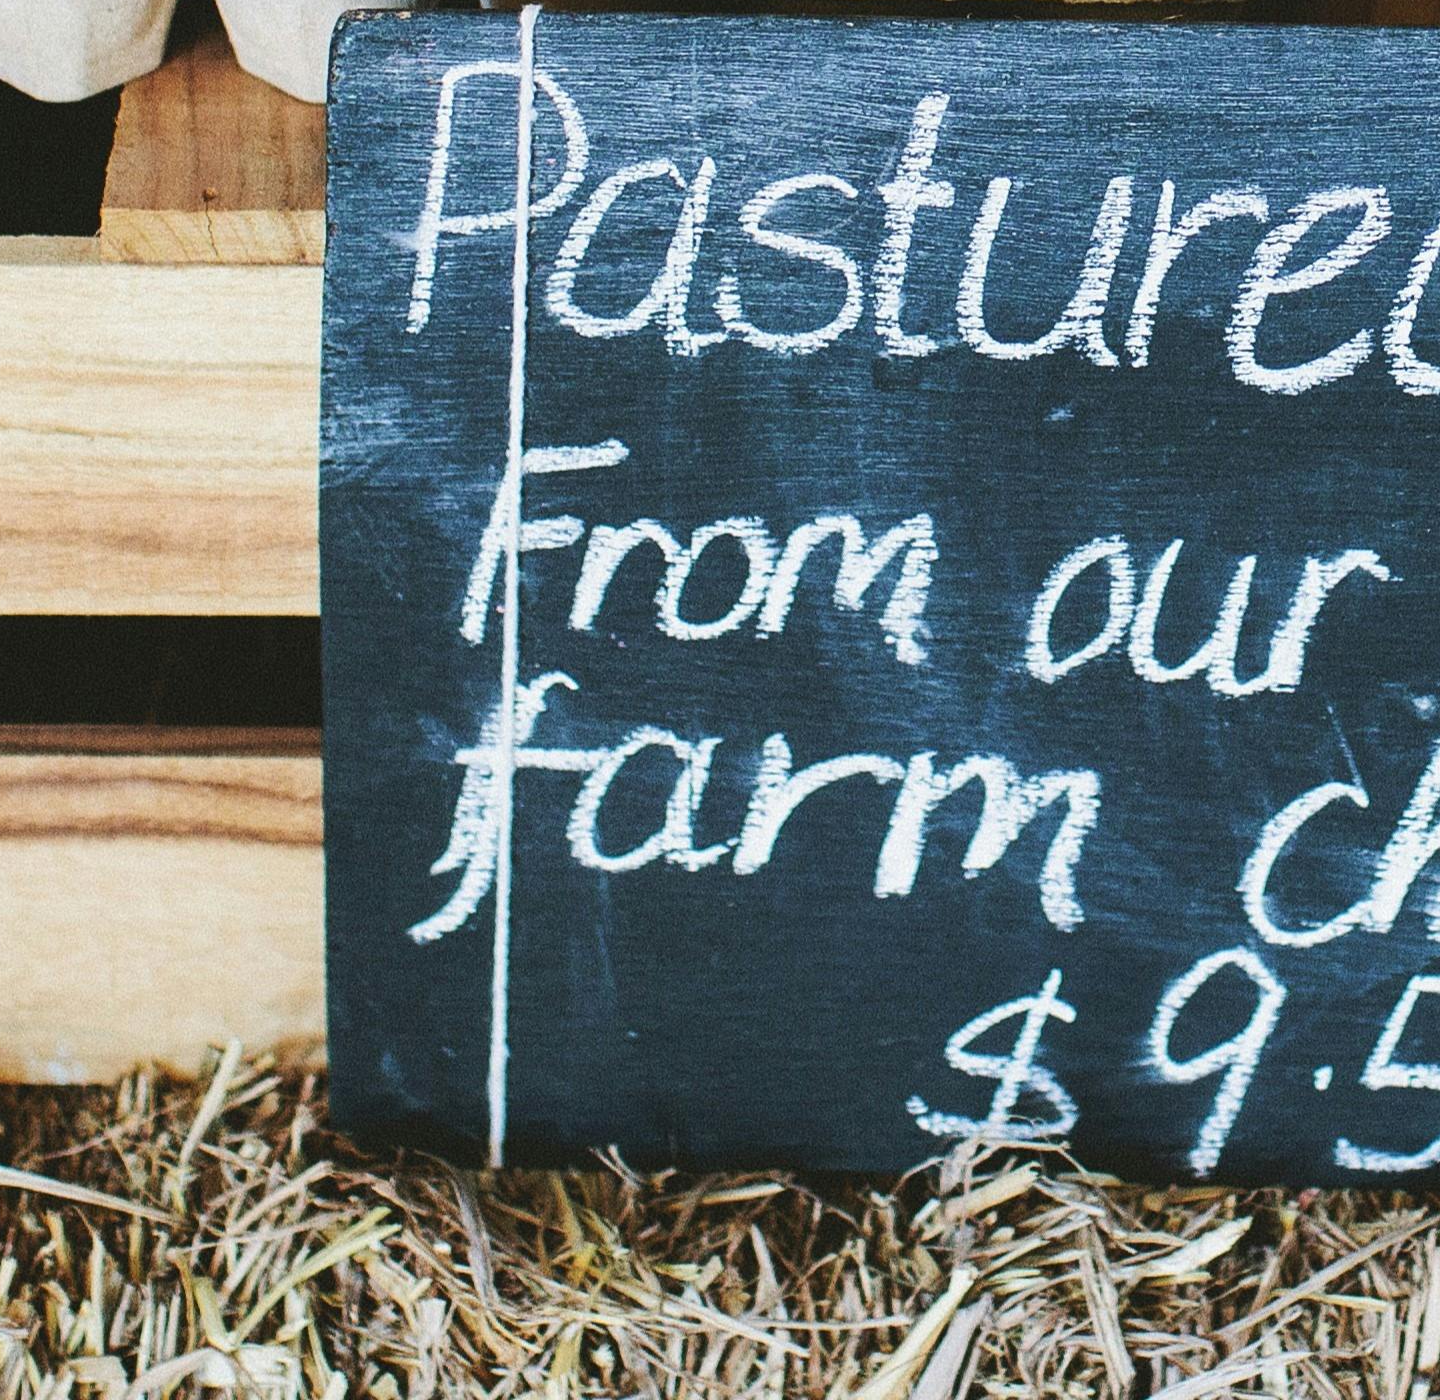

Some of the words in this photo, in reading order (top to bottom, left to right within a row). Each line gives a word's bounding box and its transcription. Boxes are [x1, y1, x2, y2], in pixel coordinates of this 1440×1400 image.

[461, 438, 938, 664] From
[1024, 535, 1406, 698] our
[407, 671, 1101, 944] farm
